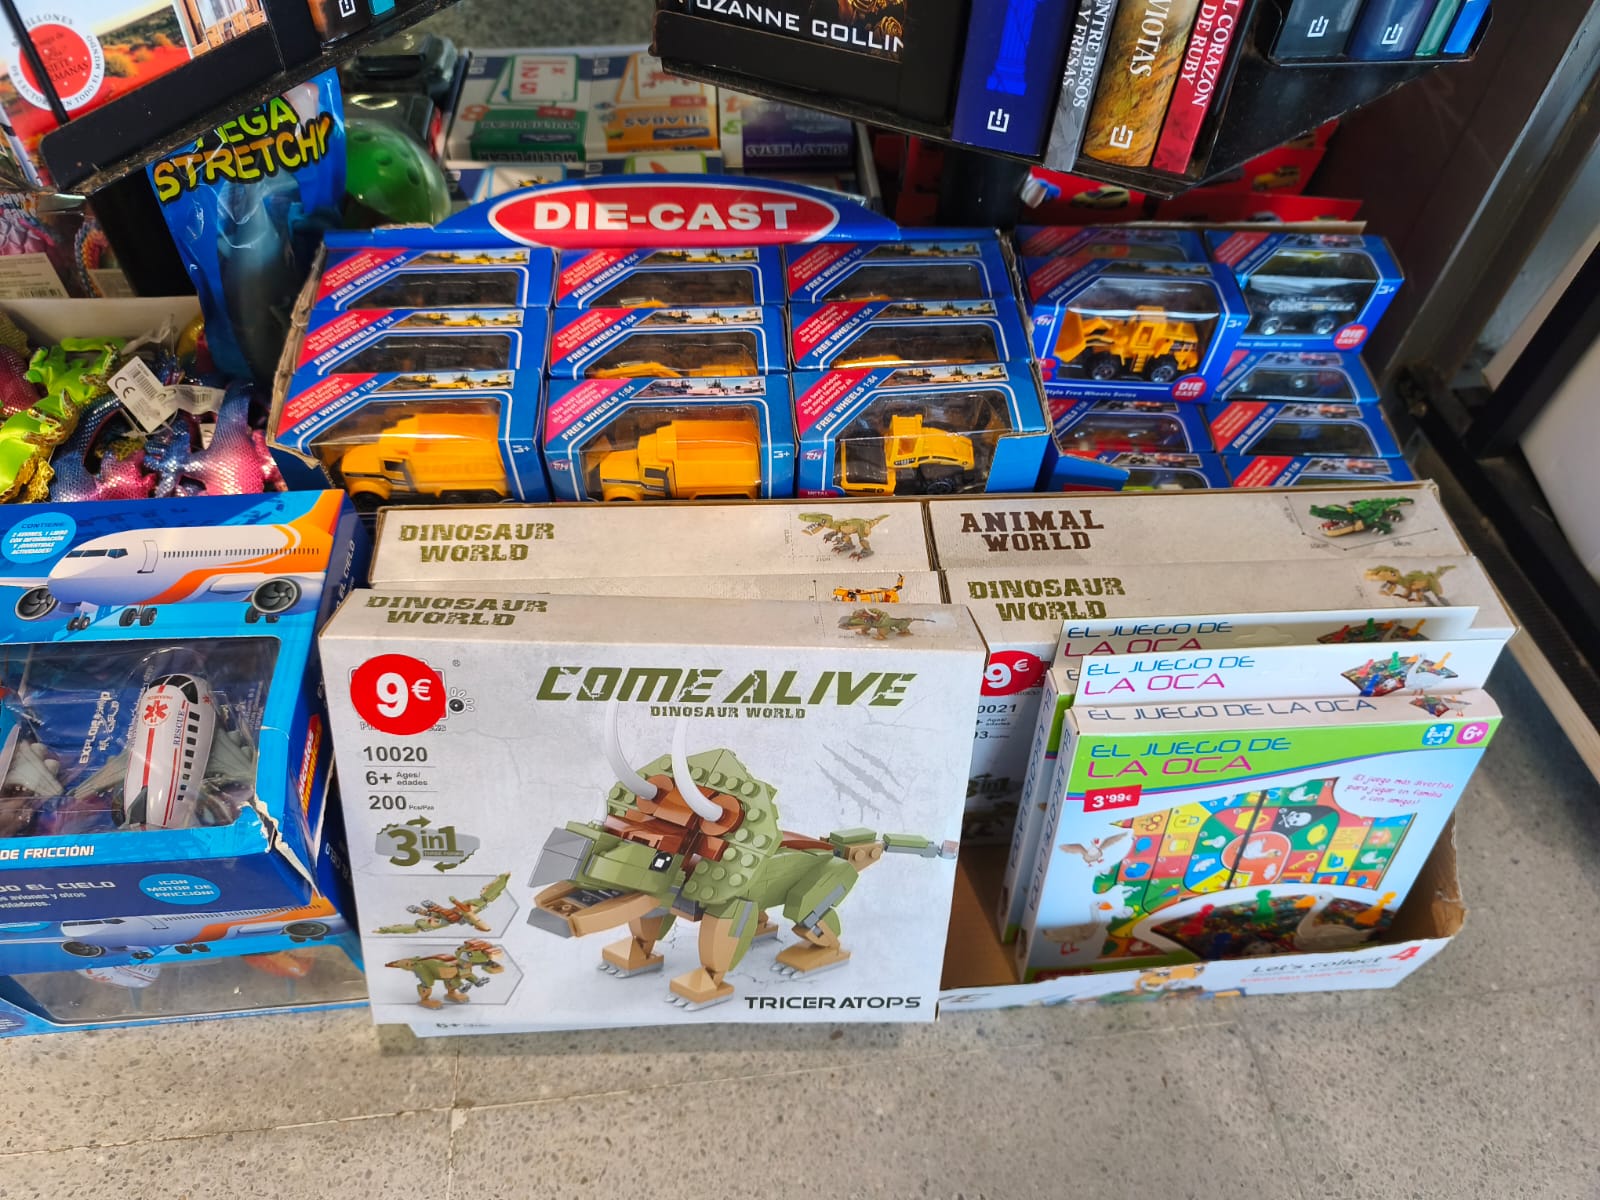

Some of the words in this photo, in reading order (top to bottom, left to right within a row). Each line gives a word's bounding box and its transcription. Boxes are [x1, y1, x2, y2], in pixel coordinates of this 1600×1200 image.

[1078, 10, 1092, 21] Y
[1196, 4, 1217, 32] DE
[1062, 24, 1088, 87] FRESAS
[1181, 34, 1208, 86] RUBY
[1192, 14, 1234, 107] CORAZÓN
[1072, 55, 1098, 108] BESOS
[153, 115, 331, 201] STRETCHY
[534, 202, 798, 231] DIE-CAST
[313, 348, 339, 366] FREE
[338, 326, 376, 350] WHEELS
[566, 347, 590, 364] FREE
[588, 325, 621, 348] WHEELS
[1178, 382, 1204, 391] DIE
[293, 415, 320, 435] FREE
[319, 391, 359, 417] WHEELS
[561, 420, 585, 441] FREE
[584, 396, 619, 423] WHEELS
[815, 412, 837, 431] FREE
[834, 386, 865, 413] WHEELS
[960, 509, 1105, 533] ANIMAL
[398, 522, 555, 543] DINOSAUR
[981, 531, 1092, 552] WORLD
[419, 543, 529, 564] WORLD
[967, 576, 1126, 600] DINOSAUR
[365, 595, 549, 613] DINOSAUR
[996, 600, 1107, 622] WORLD
[386, 610, 517, 627] WORLD
[1067, 626, 1101, 639] EL
[1108, 623, 1191, 637] JUEGO
[1196, 621, 1233, 634] DE
[1064, 641, 1115, 657] LA
[1126, 638, 1202, 654] OCA
[1087, 664, 1120, 676] EL
[1128, 657, 1213, 673] JUEGO
[1218, 656, 1255, 668] DE
[535, 666, 724, 703] COME
[721, 669, 919, 707] ALIVE
[1084, 677, 1136, 695] LA
[1147, 673, 1225, 691] OCA
[650, 705, 740, 719] DINOSAUR
[746, 706, 806, 720] WORLD
[1087, 709, 1126, 721] EL
[1134, 705, 1218, 720] JUEGO
[1224, 703, 1265, 716] DE
[1267, 702, 1311, 714] LA
[1315, 699, 1377, 713] OCA
[171, 709, 186, 745] RESCUE
[1462, 726, 1484, 741] 6+
[363, 746, 429, 763] 10020
[1091, 744, 1131, 758] EL
[1140, 739, 1241, 757] JUEGO
[1248, 737, 1292, 752] DE
[1087, 760, 1148, 779] LA
[1162, 755, 1252, 775] OCA
[365, 771, 392, 786] 6+
[1344, 784, 1368, 793] para
[1370, 786, 1395, 795] jugar
[369, 795, 407, 810] 200
[24, 845, 95, 860] FRICCIÓN!
[26, 883, 54, 891] EL
[57, 881, 116, 889] CIELO
[744, 996, 921, 1010] TRICERATOPS
